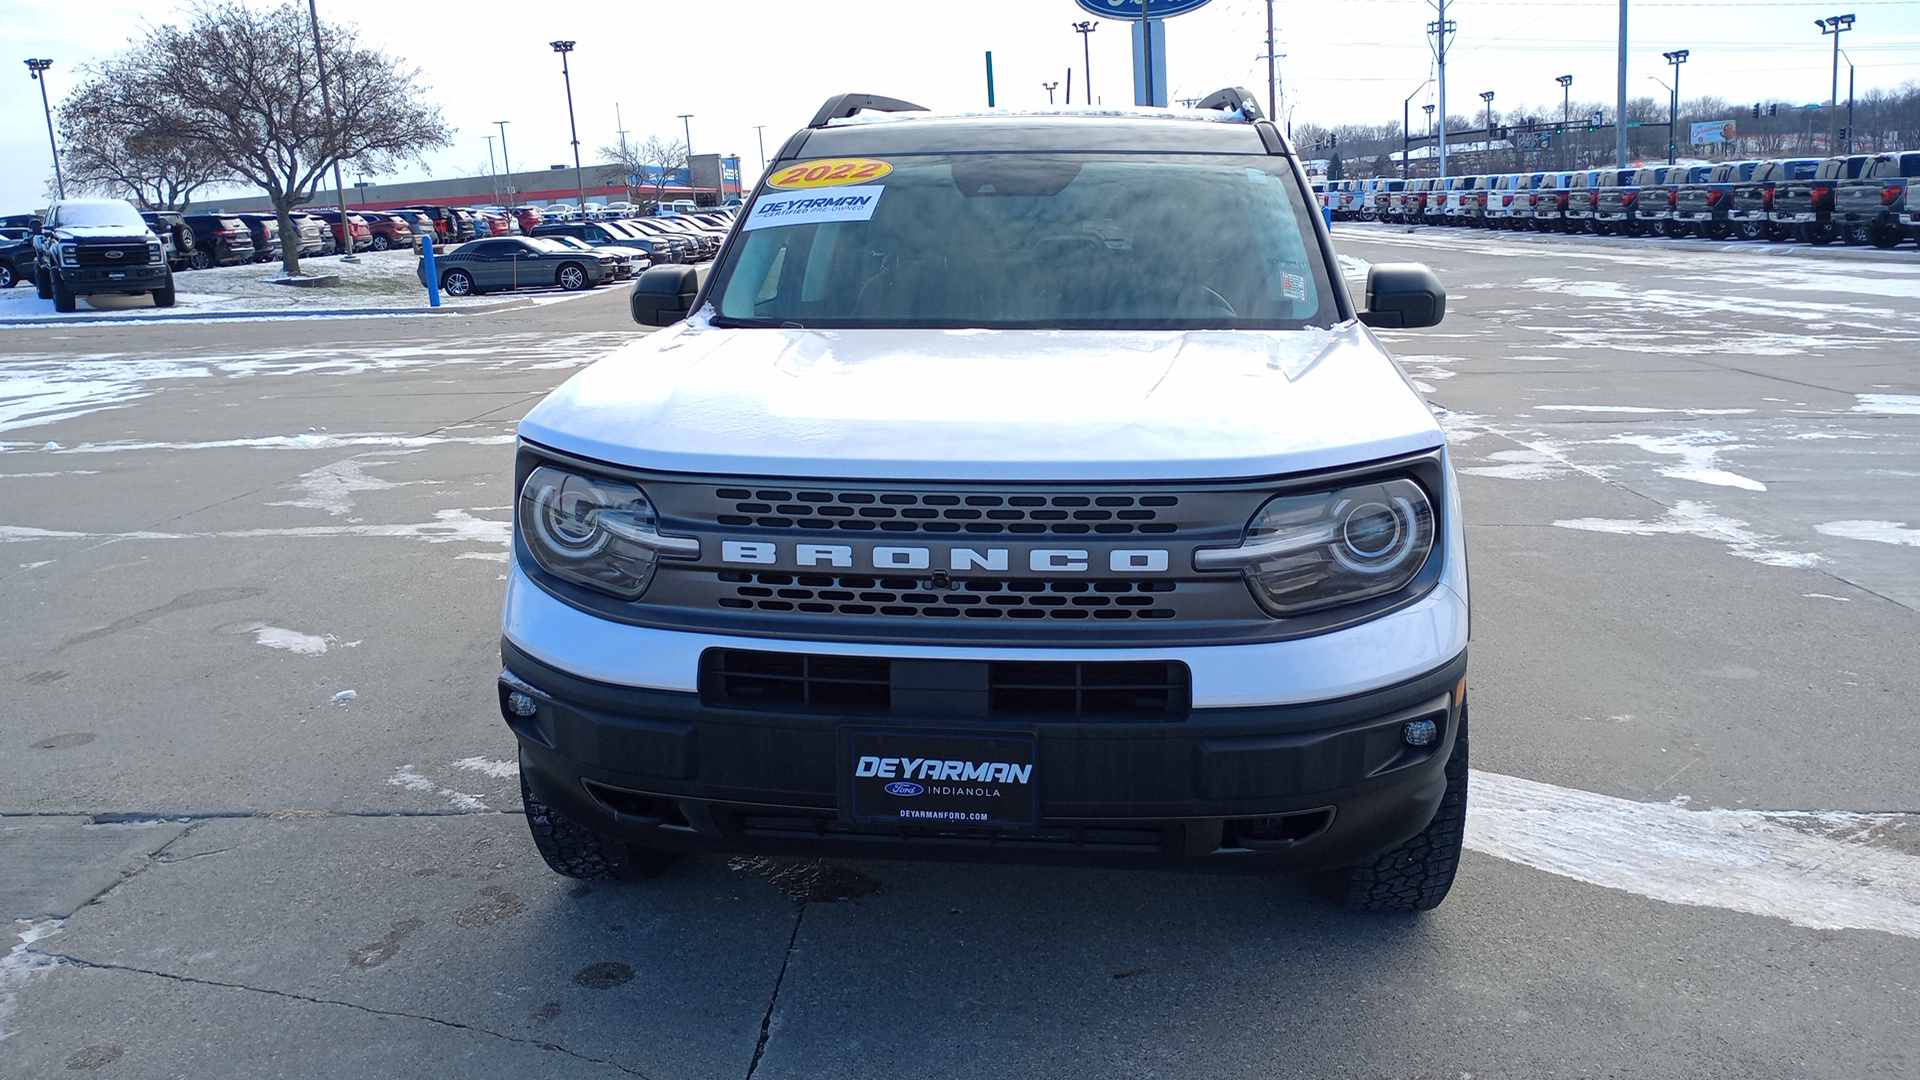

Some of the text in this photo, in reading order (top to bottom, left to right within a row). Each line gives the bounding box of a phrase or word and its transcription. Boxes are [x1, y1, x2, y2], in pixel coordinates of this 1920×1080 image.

[777, 162, 883, 185] 2022
[757, 196, 872, 214] DEYARMAN
[763, 205, 865, 218] CERTIFIED PRE-OWNED
[721, 540, 1170, 572] BRONCO
[855, 756, 1033, 784] DEYARMAN
[892, 783, 1001, 797] Ford INDIANOLA
[900, 809, 988, 821] DEYARMANFORD.COM
